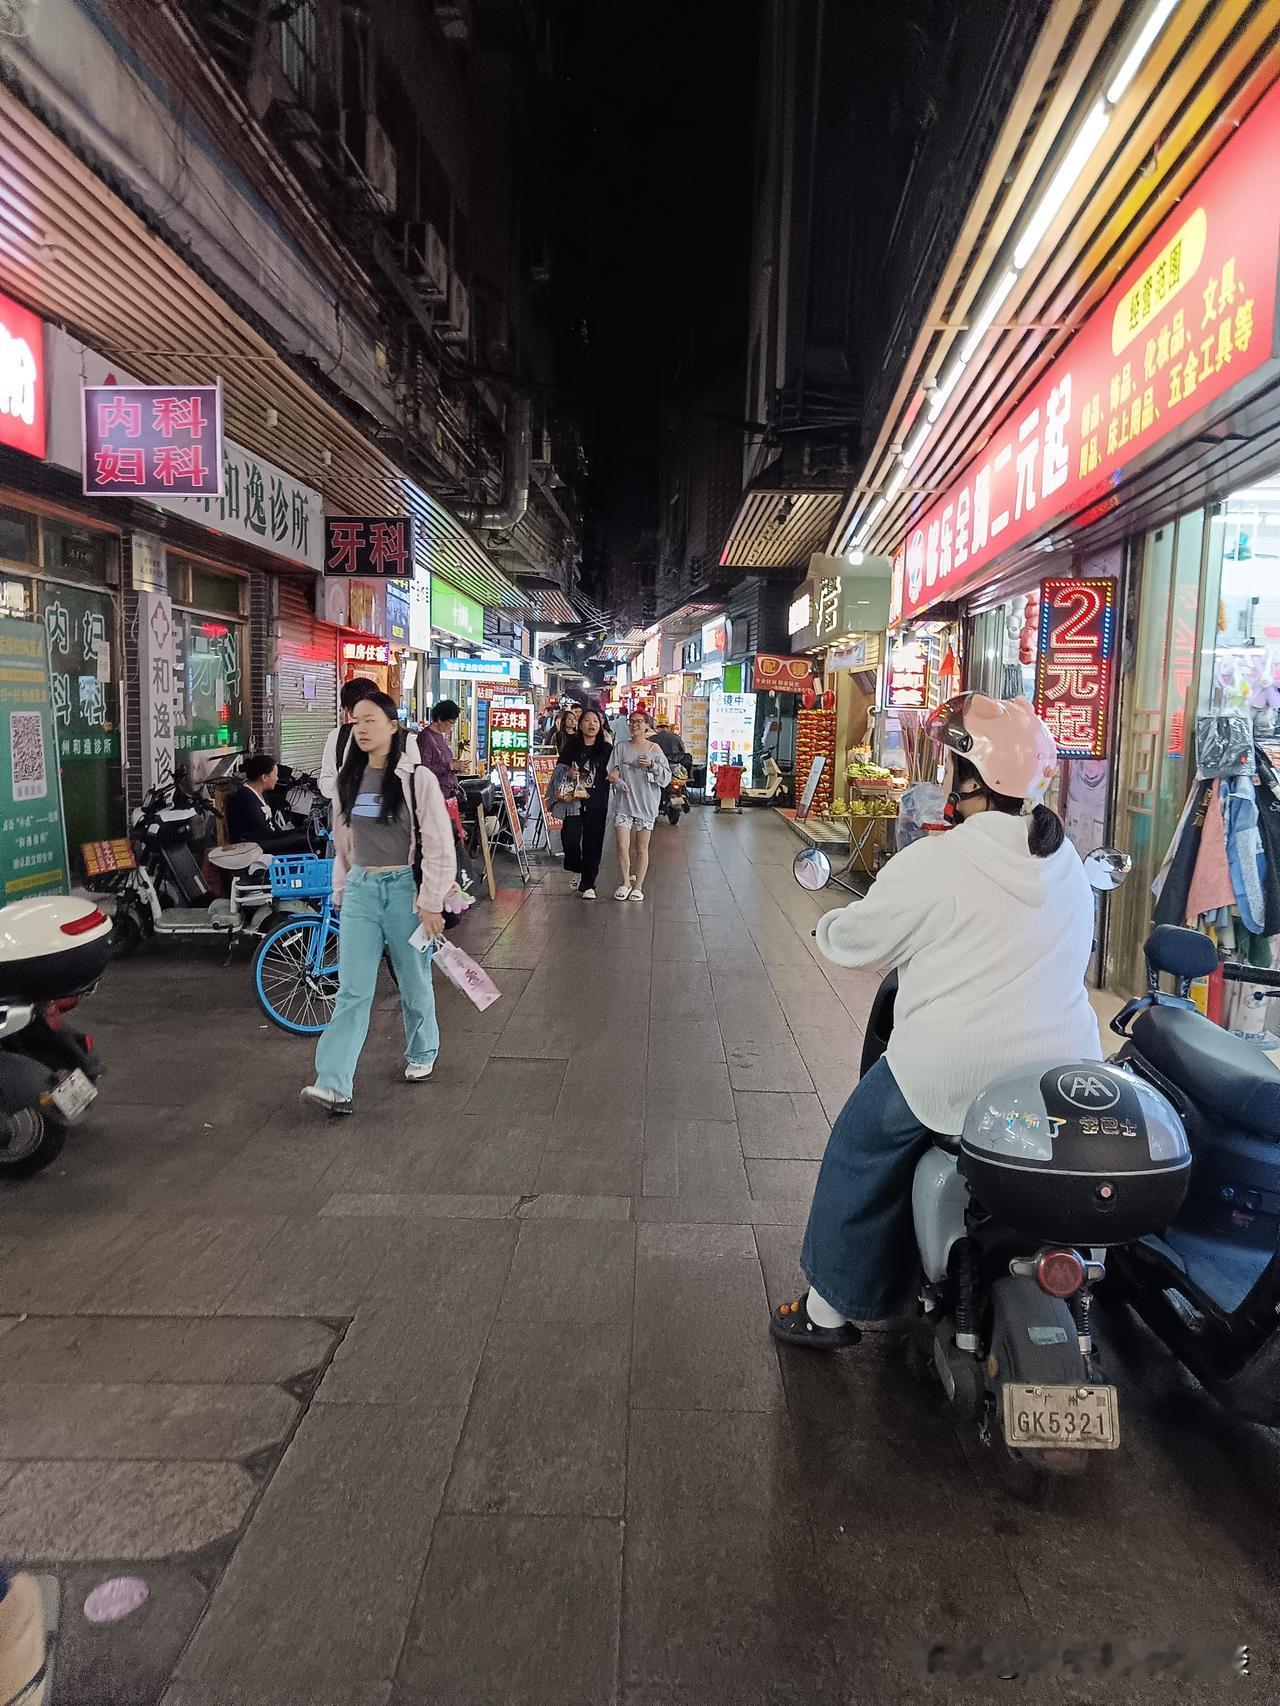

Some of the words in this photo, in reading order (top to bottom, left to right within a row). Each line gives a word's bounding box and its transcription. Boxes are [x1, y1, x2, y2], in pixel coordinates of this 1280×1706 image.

[1129, 239, 1183, 332] 经营范围
[96, 396, 208, 438] 内科
[94, 445, 208, 486] 妇科
[183, 448, 309, 556] 和逸诊所
[328, 522, 408, 573] 牙科
[1044, 587, 1099, 750] 2元起
[1017, 1411, 1105, 1436] GK5321
